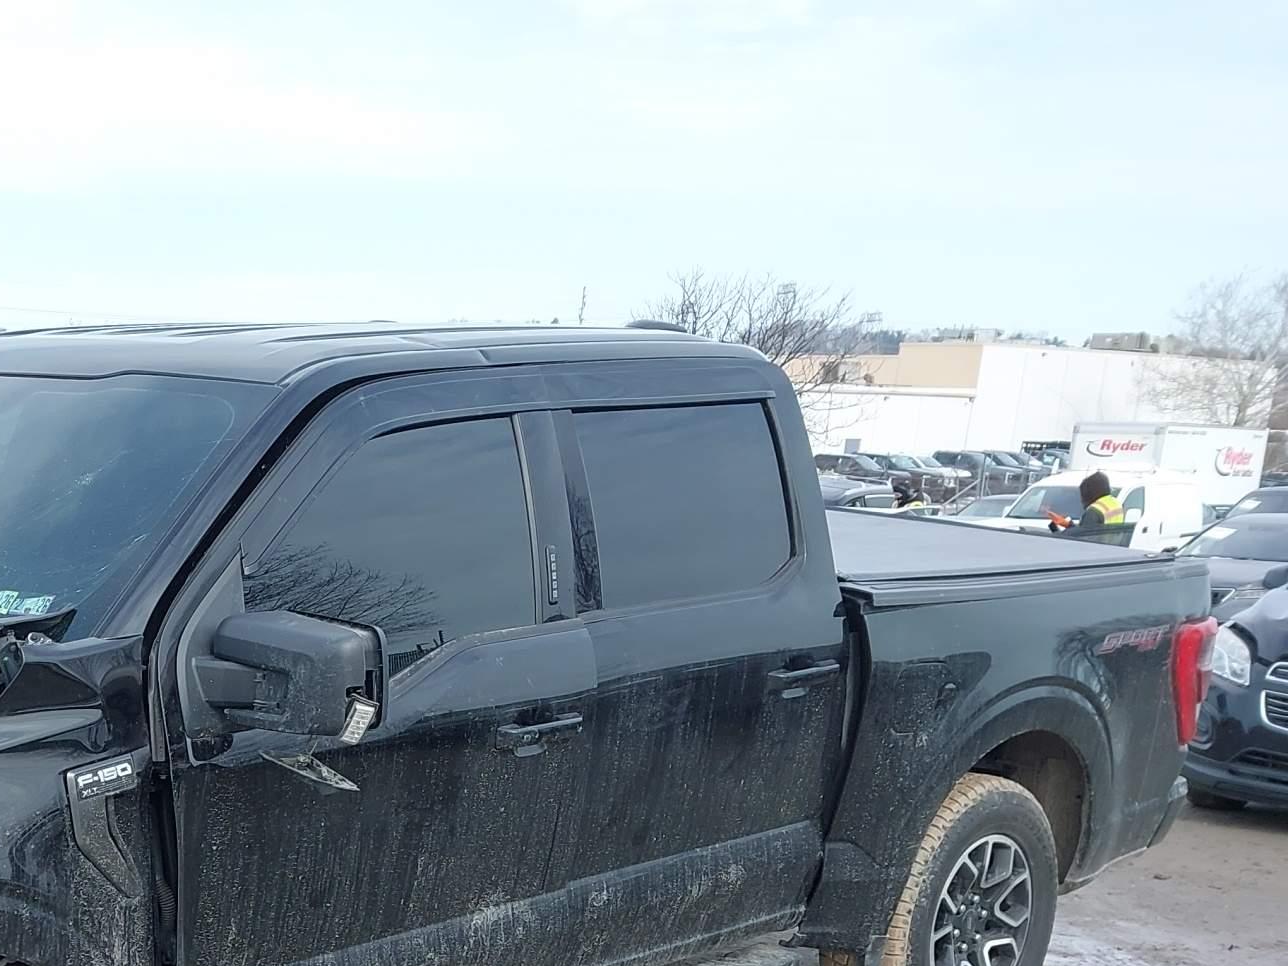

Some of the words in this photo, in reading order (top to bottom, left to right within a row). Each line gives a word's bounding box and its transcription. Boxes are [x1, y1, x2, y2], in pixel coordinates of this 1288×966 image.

[1100, 439, 1149, 454] Ryder
[1223, 446, 1253, 469] Ryder
[77, 762, 132, 789] F-150
[81, 786, 98, 799] XLT
